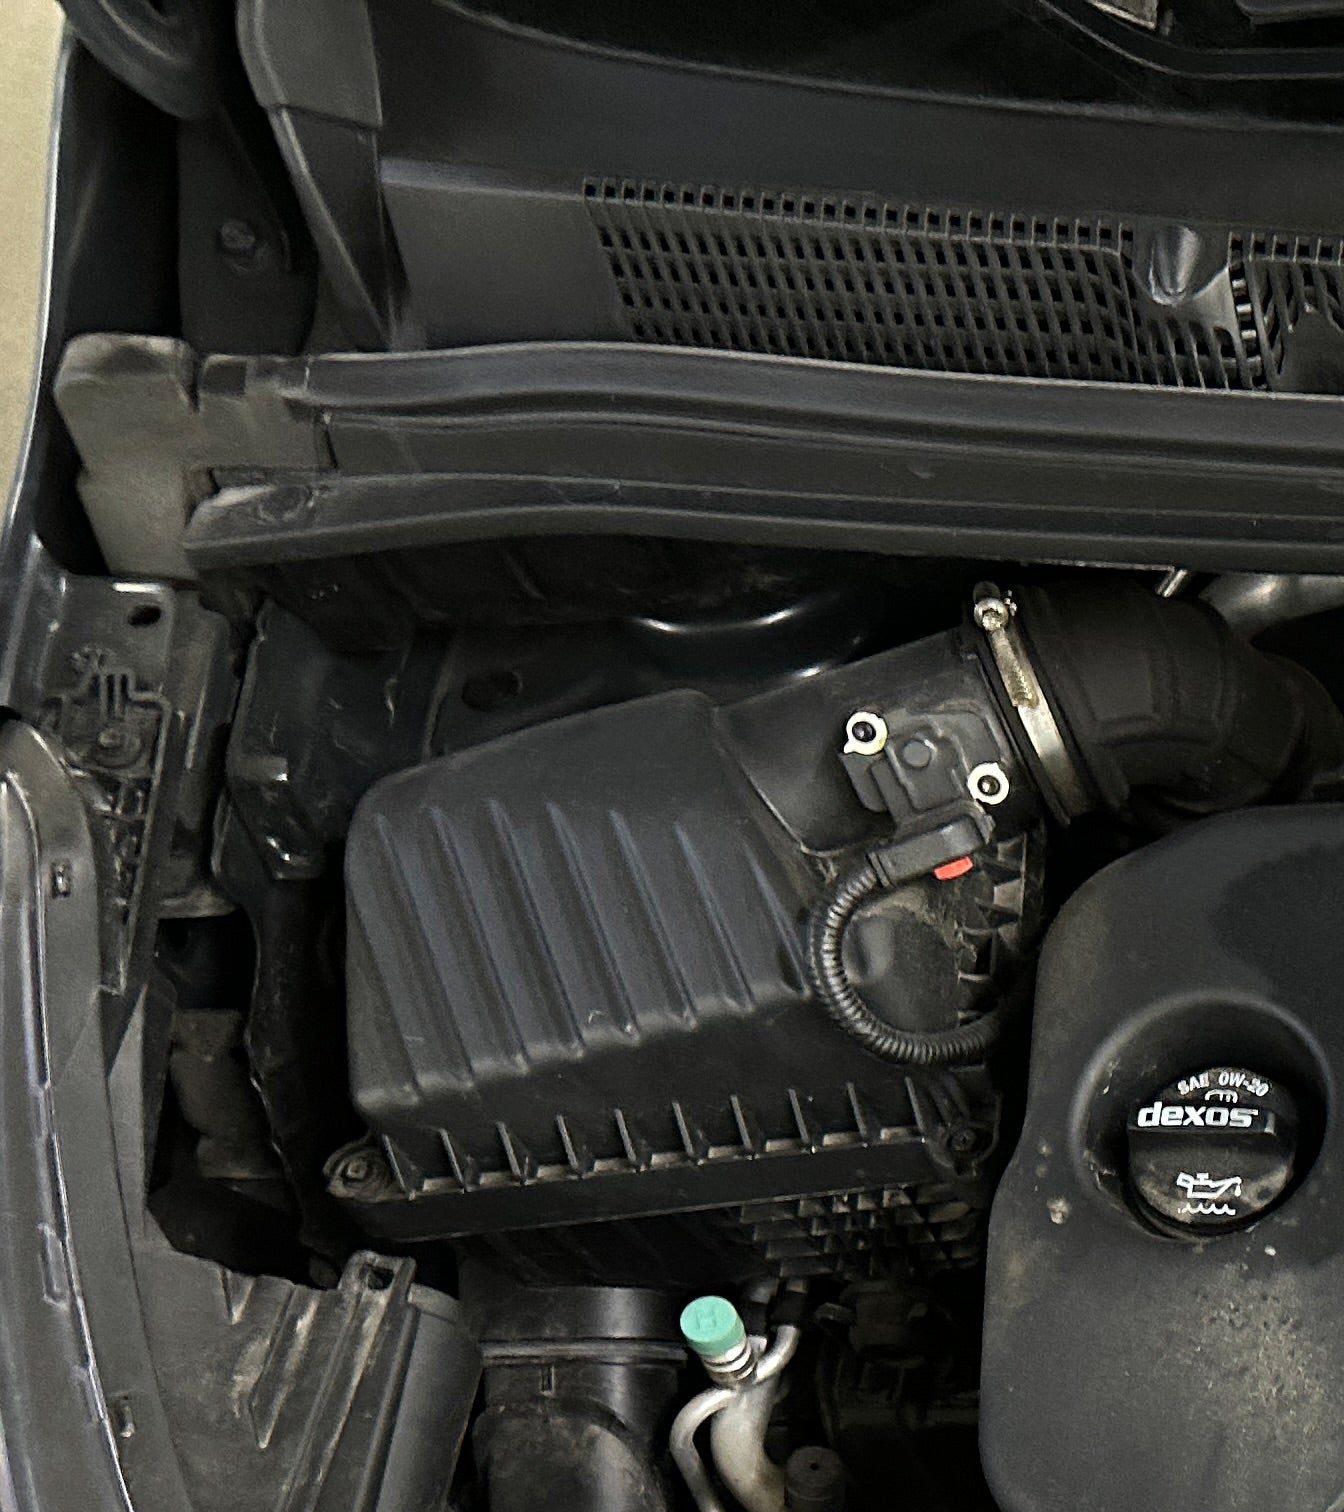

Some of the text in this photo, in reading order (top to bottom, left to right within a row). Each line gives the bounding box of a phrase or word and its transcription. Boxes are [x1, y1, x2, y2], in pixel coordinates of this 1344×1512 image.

[1177, 1071, 1269, 1097] SAE 0W-20
[1137, 1101, 1254, 1127] dexos
